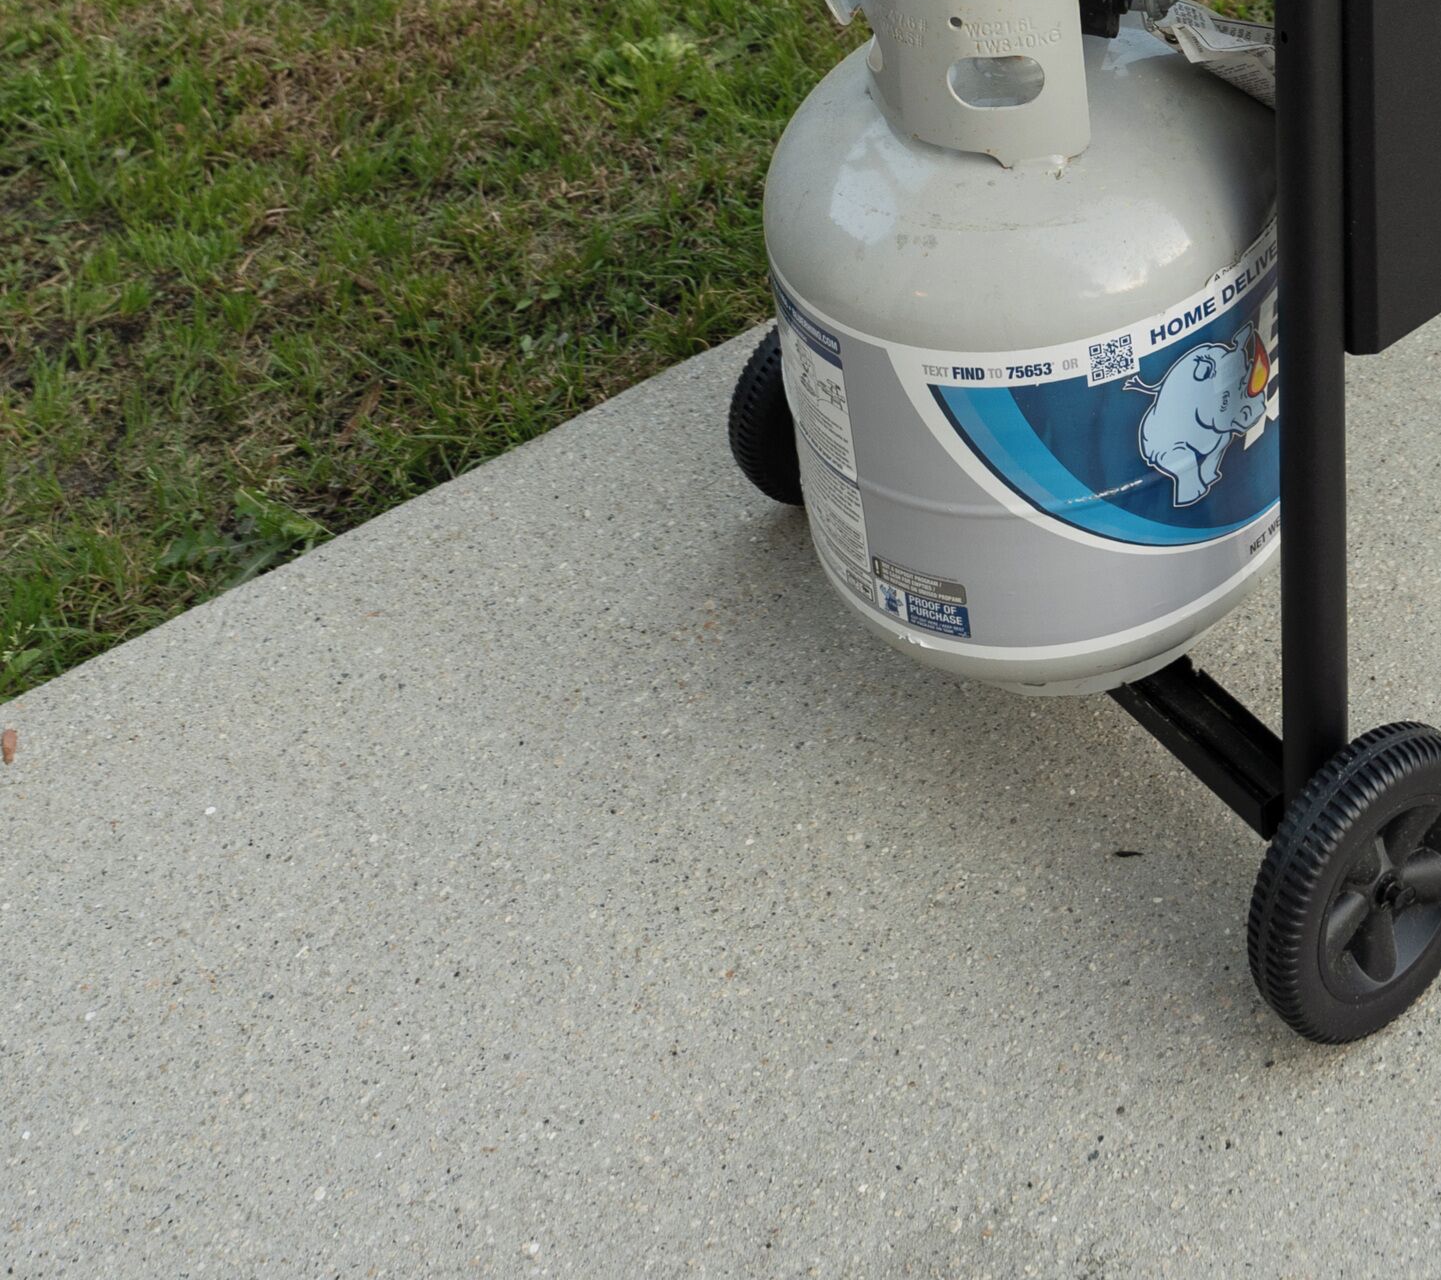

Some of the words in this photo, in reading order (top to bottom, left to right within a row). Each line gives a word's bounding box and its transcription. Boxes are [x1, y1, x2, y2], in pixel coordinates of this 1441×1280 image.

[1150, 297, 1217, 345] HOME
[921, 364, 949, 378] TEXT
[952, 366, 985, 380] FIND
[988, 367, 1003, 379] TO
[1062, 358, 1079, 371] OR
[1250, 531, 1266, 555] NET
[909, 595, 941, 612] PROOF
[943, 605, 957, 615] OF
[910, 604, 963, 626] PURCHASE
